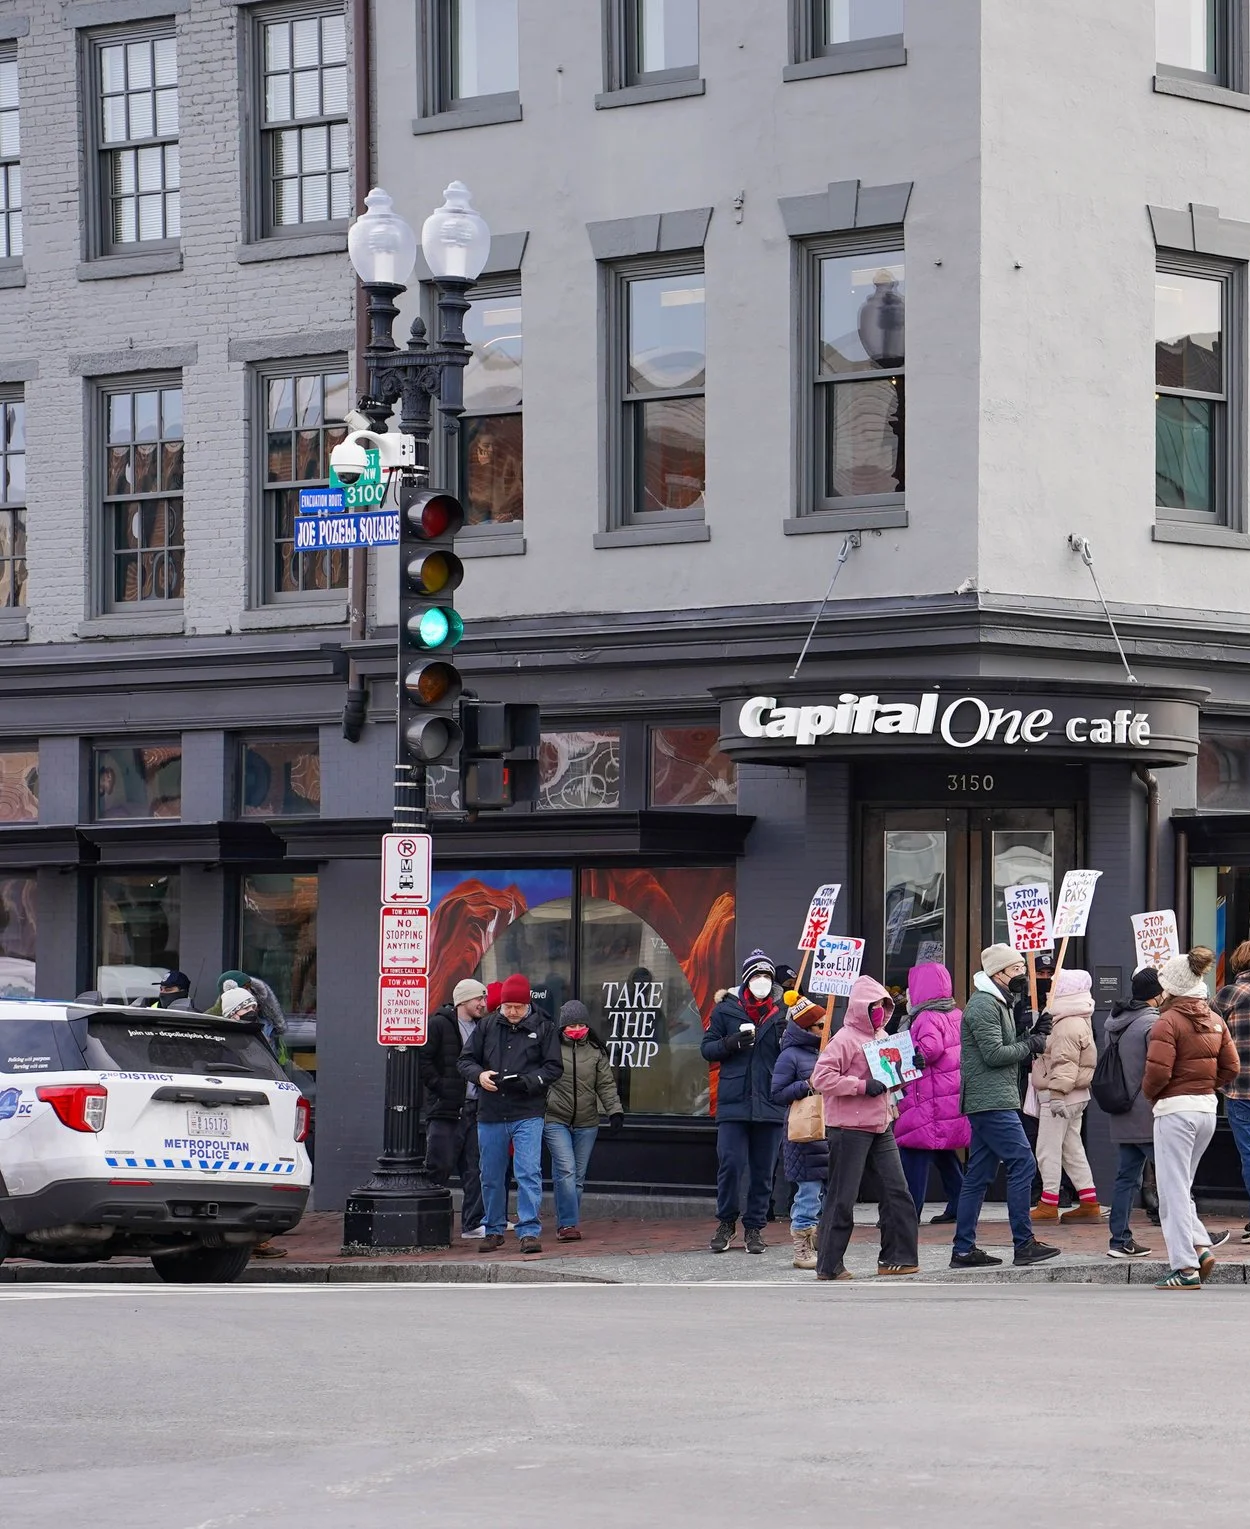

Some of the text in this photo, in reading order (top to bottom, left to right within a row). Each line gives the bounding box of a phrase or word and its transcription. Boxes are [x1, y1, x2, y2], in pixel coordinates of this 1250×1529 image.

[364, 468, 376, 480] NW
[347, 484, 385, 504] 3100
[328, 494, 342, 507] ROUTE
[298, 521, 316, 546] JOE
[360, 514, 400, 546] SQUARE
[1065, 709, 1150, 746] café
[947, 774, 994, 791] 3150
[1015, 888, 1039, 899] STOP
[1065, 888, 1086, 902] PAYS
[1007, 898, 1048, 910] STARVING
[811, 908, 829, 918] GAZA
[1011, 908, 1044, 920] GAZA
[397, 919, 412, 928] NO
[1144, 915, 1163, 927] STOP
[386, 930, 422, 939] STOPPING
[1017, 932, 1042, 941] DROP
[1137, 925, 1173, 940] STARVING
[820, 939, 851, 953] Capital
[1015, 939, 1047, 950] ELBIT
[1141, 937, 1169, 950] GAZA
[836, 957, 861, 972] ELBIT
[396, 989, 410, 997] NO
[602, 982, 664, 1008] TAKE
[608, 1012, 655, 1038] THE
[605, 1041, 658, 1067] TRIP
[120, 1073, 174, 1081] DISTRICT
[18, 1104, 32, 1113] DC
[204, 1118, 228, 1130] 15173
[164, 1139, 249, 1151] METROPOLITAN
[189, 1149, 230, 1160] POLICE
